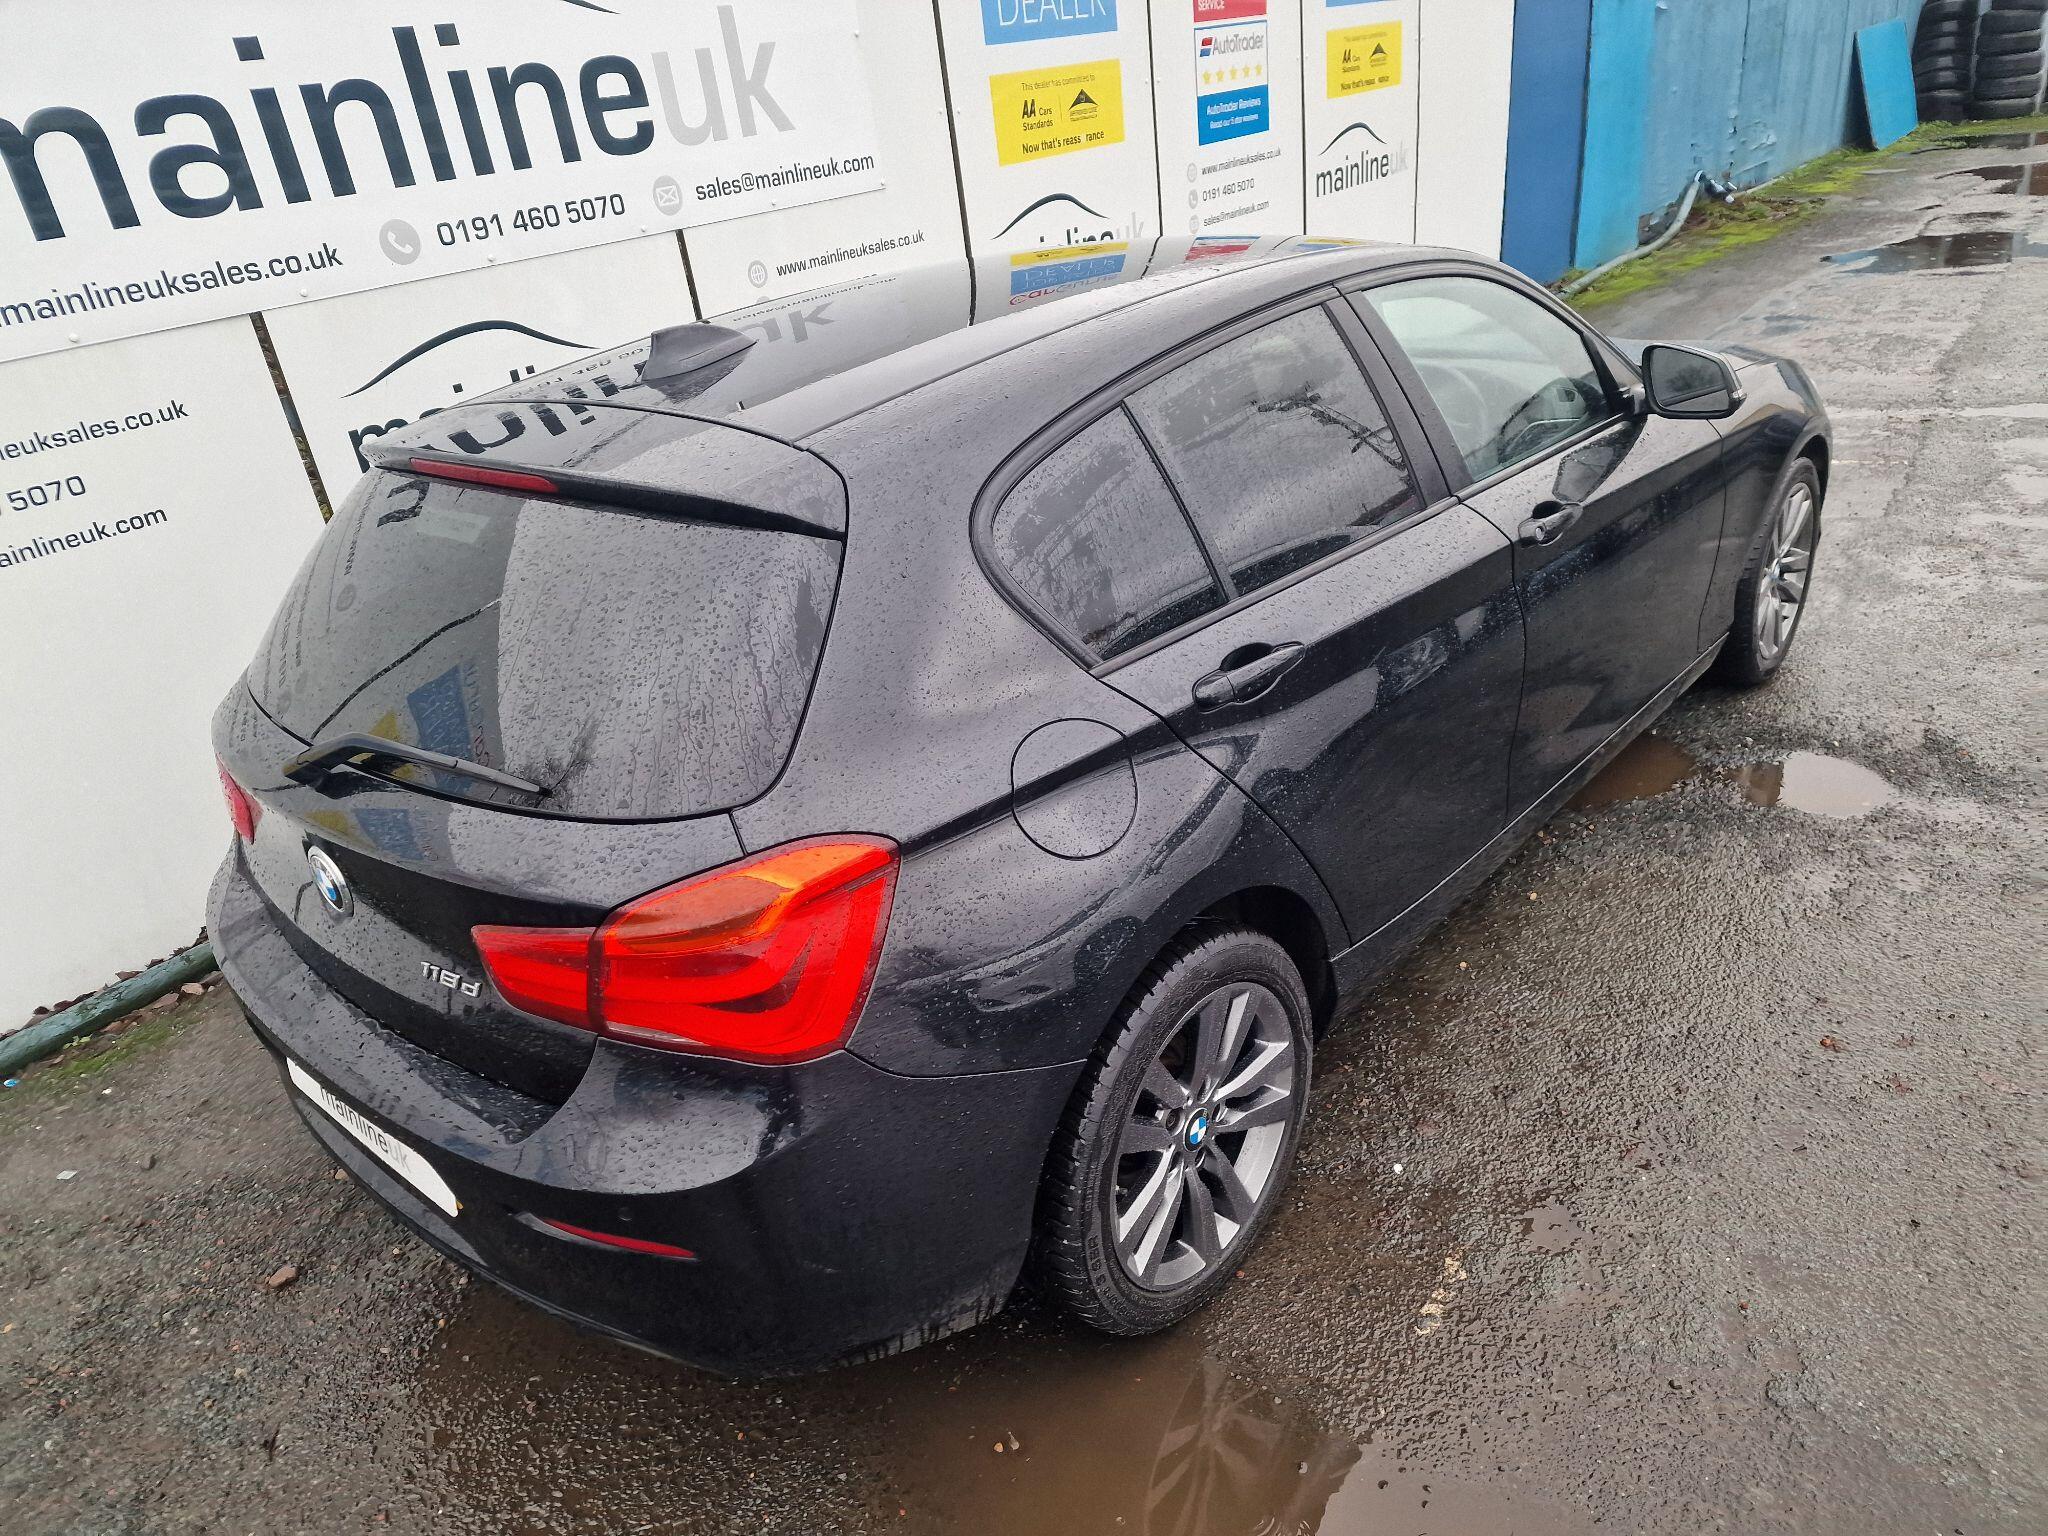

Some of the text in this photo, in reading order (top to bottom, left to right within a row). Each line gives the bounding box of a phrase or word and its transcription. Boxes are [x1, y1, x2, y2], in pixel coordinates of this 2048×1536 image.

[1212, 32, 1264, 55] AutoTrader
[1021, 82, 1034, 91] This
[1034, 79, 1051, 90] dealer
[1051, 78, 1062, 87] has
[0, 5, 796, 241] mainlineuk
[1022, 98, 1036, 119] AA
[1038, 106, 1053, 117] Cars
[1022, 118, 1054, 132] Standards
[1206, 97, 1262, 116] AutoTrader Reviews
[1022, 130, 1105, 155] Now that's reassrance
[695, 155, 875, 201] sales@mainlineuk.com
[1316, 140, 1408, 198] mainlineuk
[1202, 187, 1220, 202] 0191
[1237, 178, 1255, 192] 5070
[436, 193, 626, 246] 0191 460 5070
[776, 229, 926, 277] www.mainlineuksales.co.uk
[6, 475, 87, 512] 5070
[420, 961, 482, 998] 118d
[321, 1087, 411, 1174] mainlineuk
